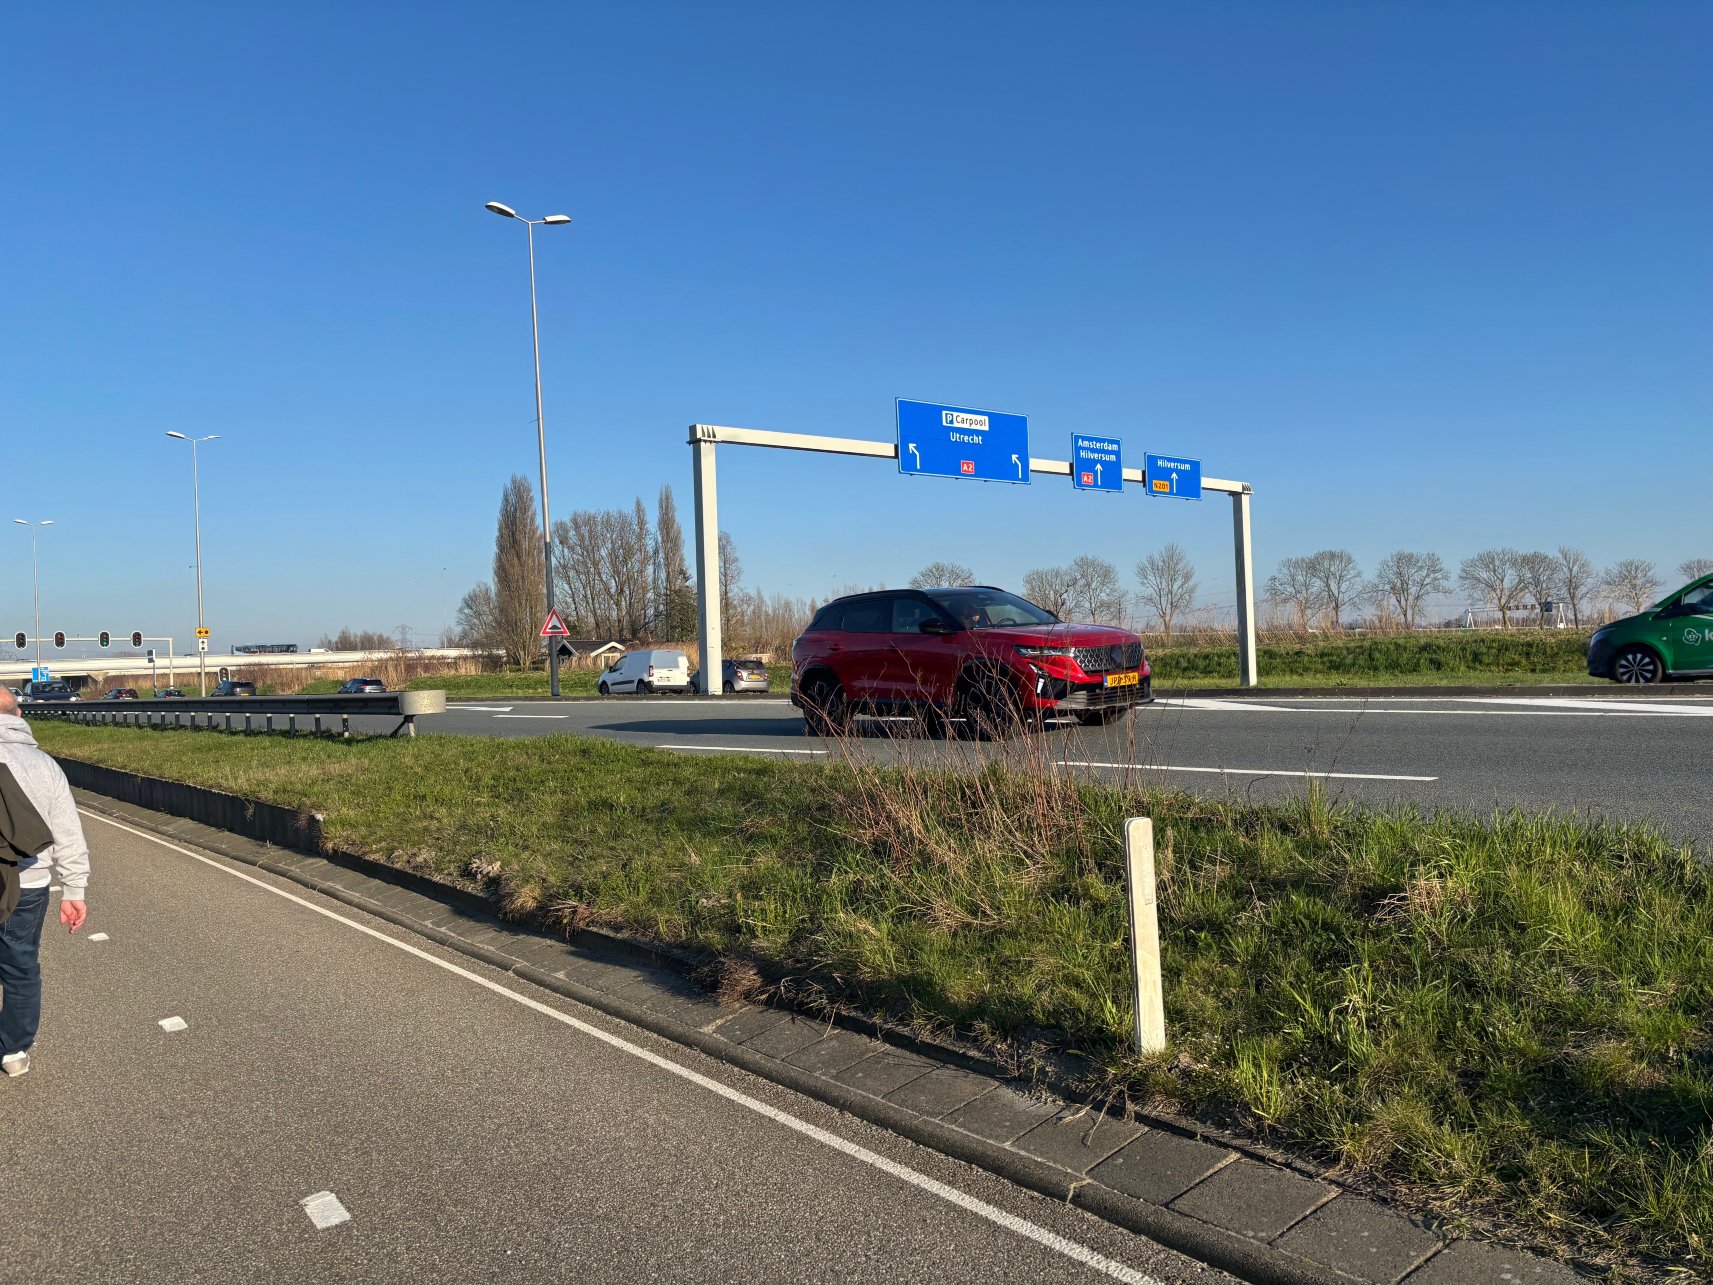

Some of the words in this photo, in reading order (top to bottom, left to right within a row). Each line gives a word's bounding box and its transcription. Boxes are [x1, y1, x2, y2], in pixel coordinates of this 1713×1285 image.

[946, 414, 953, 423] P
[955, 415, 986, 427] Carpool
[950, 431, 983, 444] Utrecht
[1077, 438, 1119, 451] Amsterdam
[1080, 449, 1116, 461] Hilversum
[962, 463, 973, 472] A2
[1157, 459, 1191, 471] Hilversum
[1083, 474, 1093, 483] A2
[1154, 481, 1169, 490] N201
